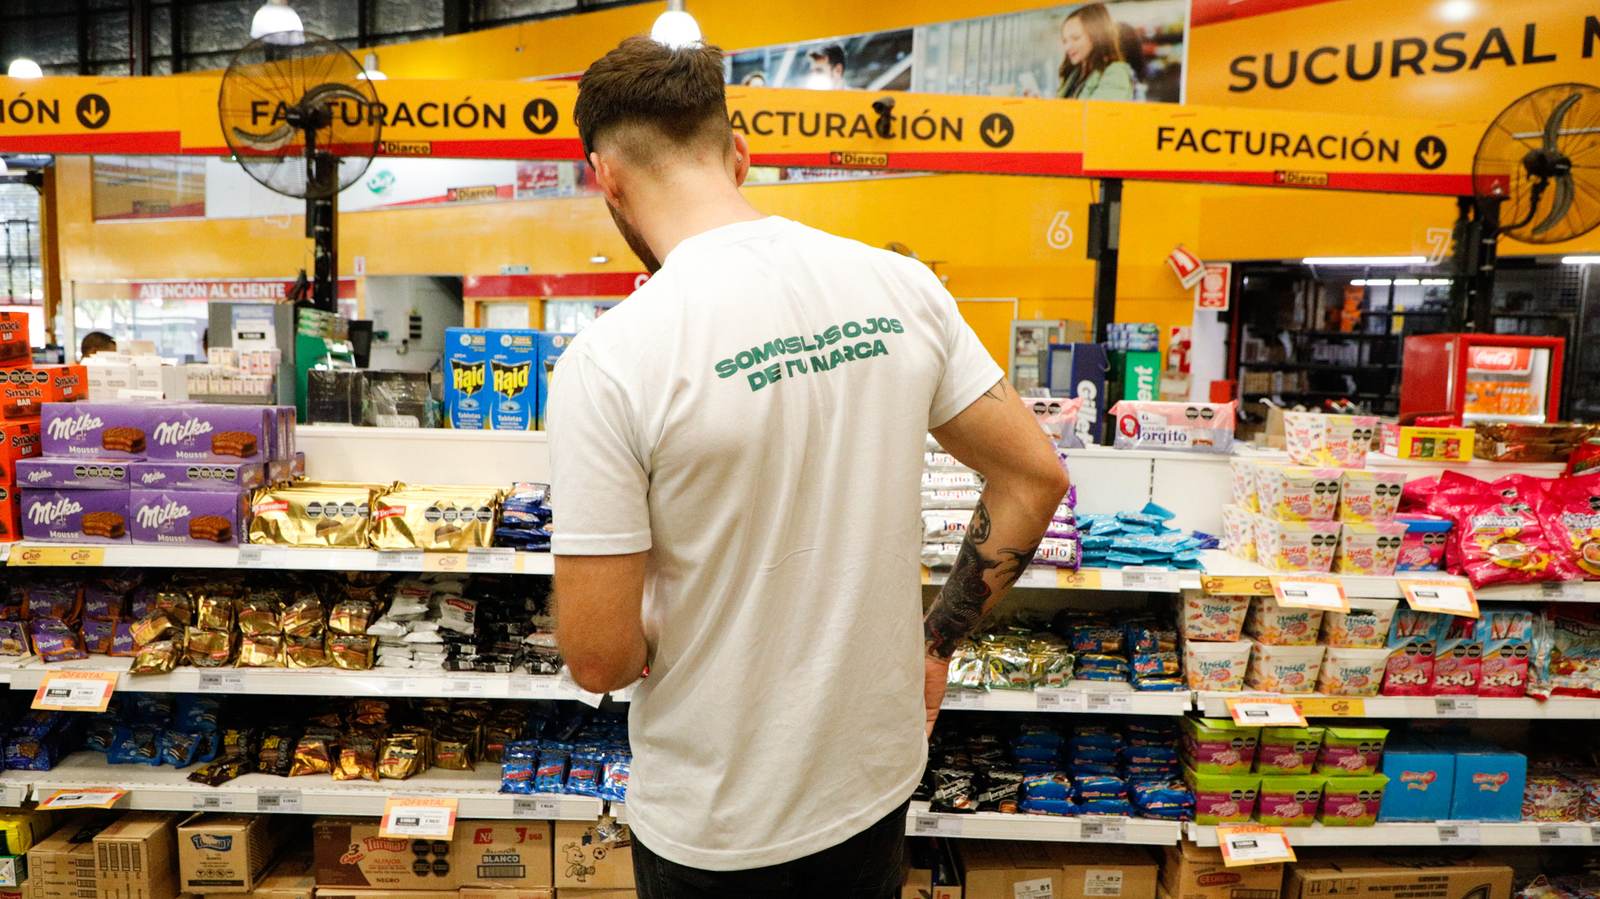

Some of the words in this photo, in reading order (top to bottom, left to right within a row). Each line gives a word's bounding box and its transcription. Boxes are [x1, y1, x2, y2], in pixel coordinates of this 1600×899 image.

[1228, 22, 1557, 92] SUCURSAL
[251, 96, 505, 129] FATURACIÓN
[729, 109, 963, 141] ACTURACIÓN
[388, 142, 429, 153] Diarco
[1156, 127, 1399, 163] FACTURACIÓN
[843, 154, 886, 165] Diarco
[1287, 172, 1326, 185] Diarco
[1046, 211, 1073, 250] 6
[1426, 228, 1452, 267] 7
[140, 282, 206, 299] ATENCIÓN
[209, 284, 228, 298] AL
[230, 283, 285, 298] CLIENTE
[0, 320, 20, 330] mack
[842, 317, 904, 338] OJOS
[453, 365, 485, 390] Raid
[493, 365, 528, 392] Raid
[747, 362, 782, 392] DE
[785, 357, 809, 378] TU
[5, 387, 43, 398] Smack
[17, 399, 31, 407] BAR
[47, 413, 104, 441] Milka
[153, 417, 214, 446] Milka
[68, 445, 99, 455] Mousse
[175, 450, 208, 459] Mousse
[28, 469, 53, 482] Milka
[141, 471, 166, 484] Milka
[28, 498, 83, 526] Milka
[136, 501, 191, 529] Milka
[49, 530, 80, 540] Mousse
[157, 534, 187, 543] Mousse
[483, 855, 519, 863] BLANCO
